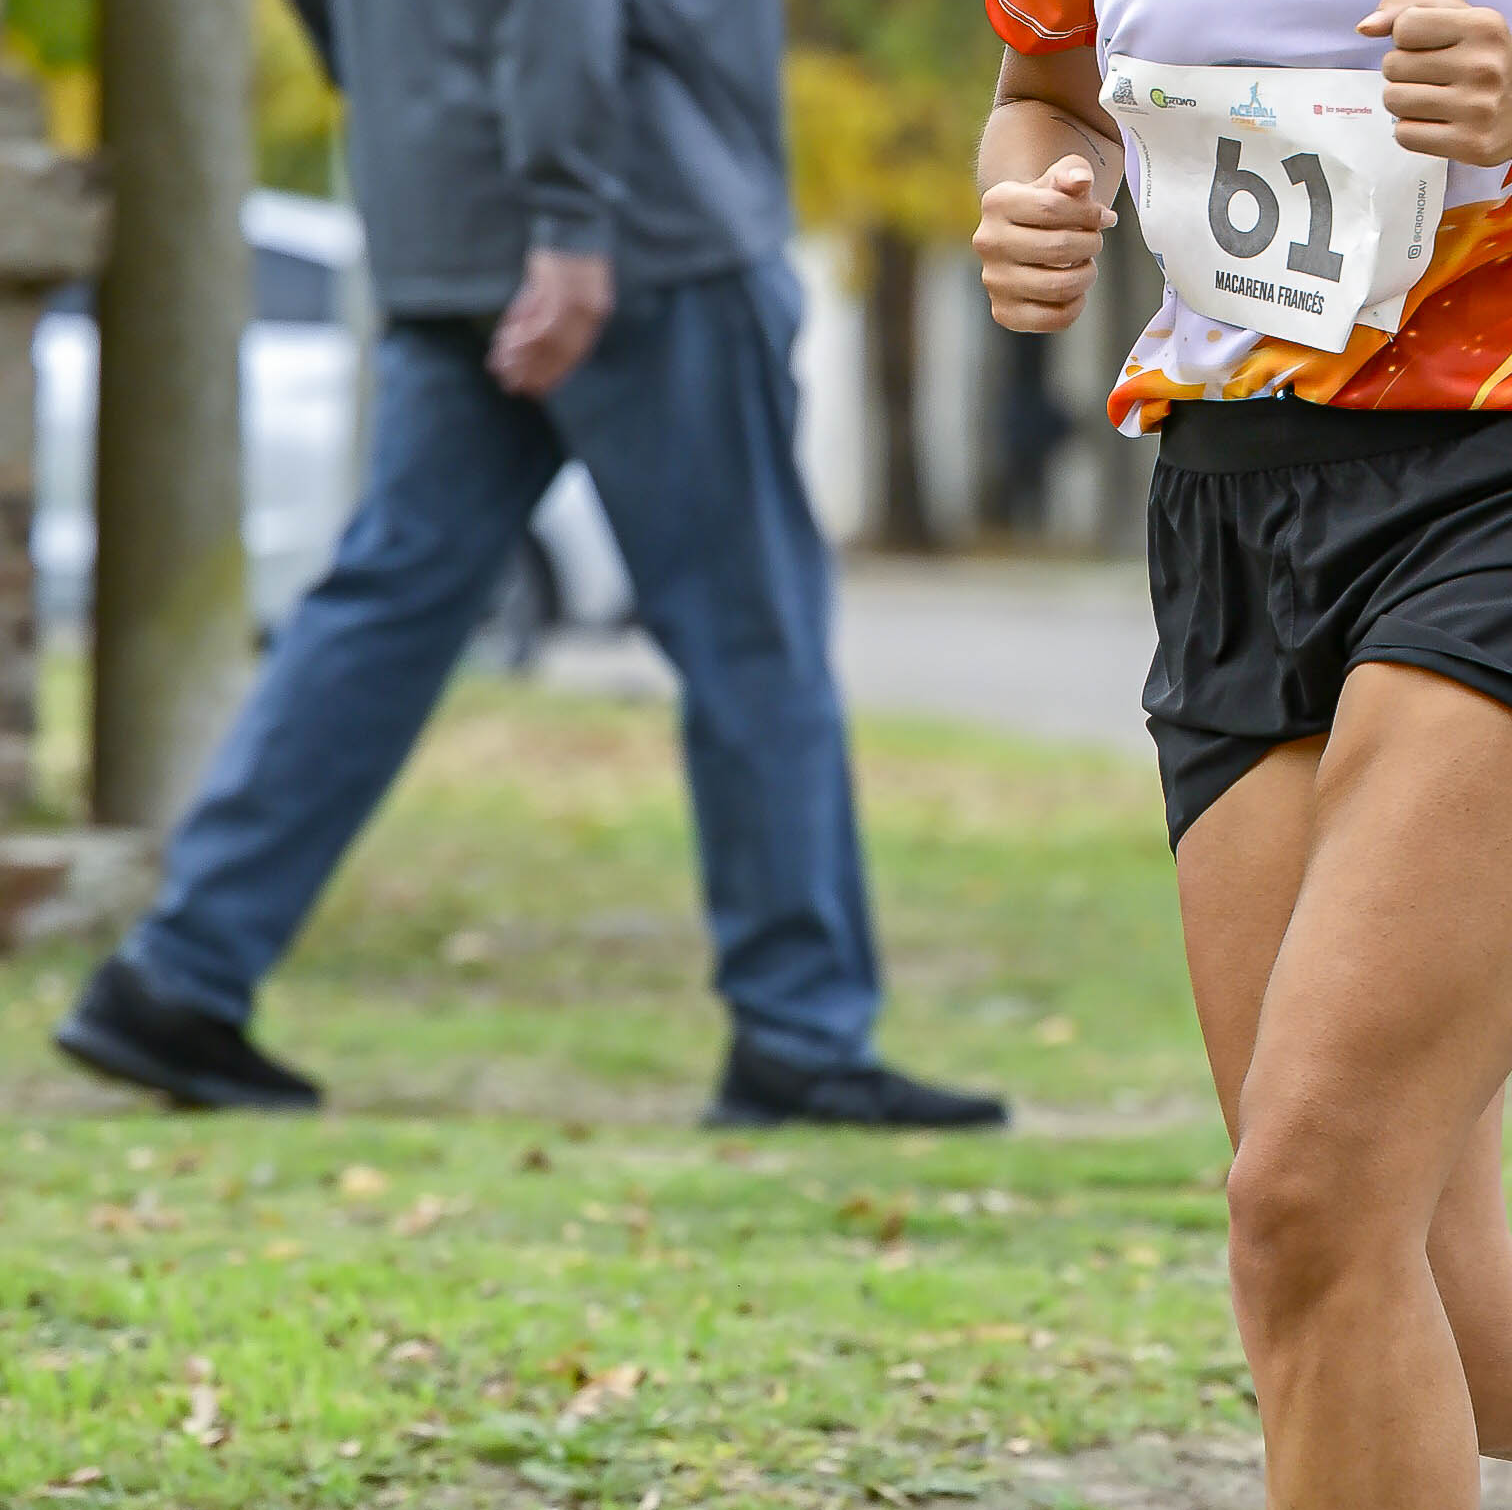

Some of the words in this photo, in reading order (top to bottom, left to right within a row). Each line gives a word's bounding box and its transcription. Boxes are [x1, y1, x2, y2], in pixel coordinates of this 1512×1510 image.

[1208, 136, 1345, 283] 61
[1215, 270, 1275, 303] MACARENA
[1276, 285, 1325, 316] FRANCÉS
